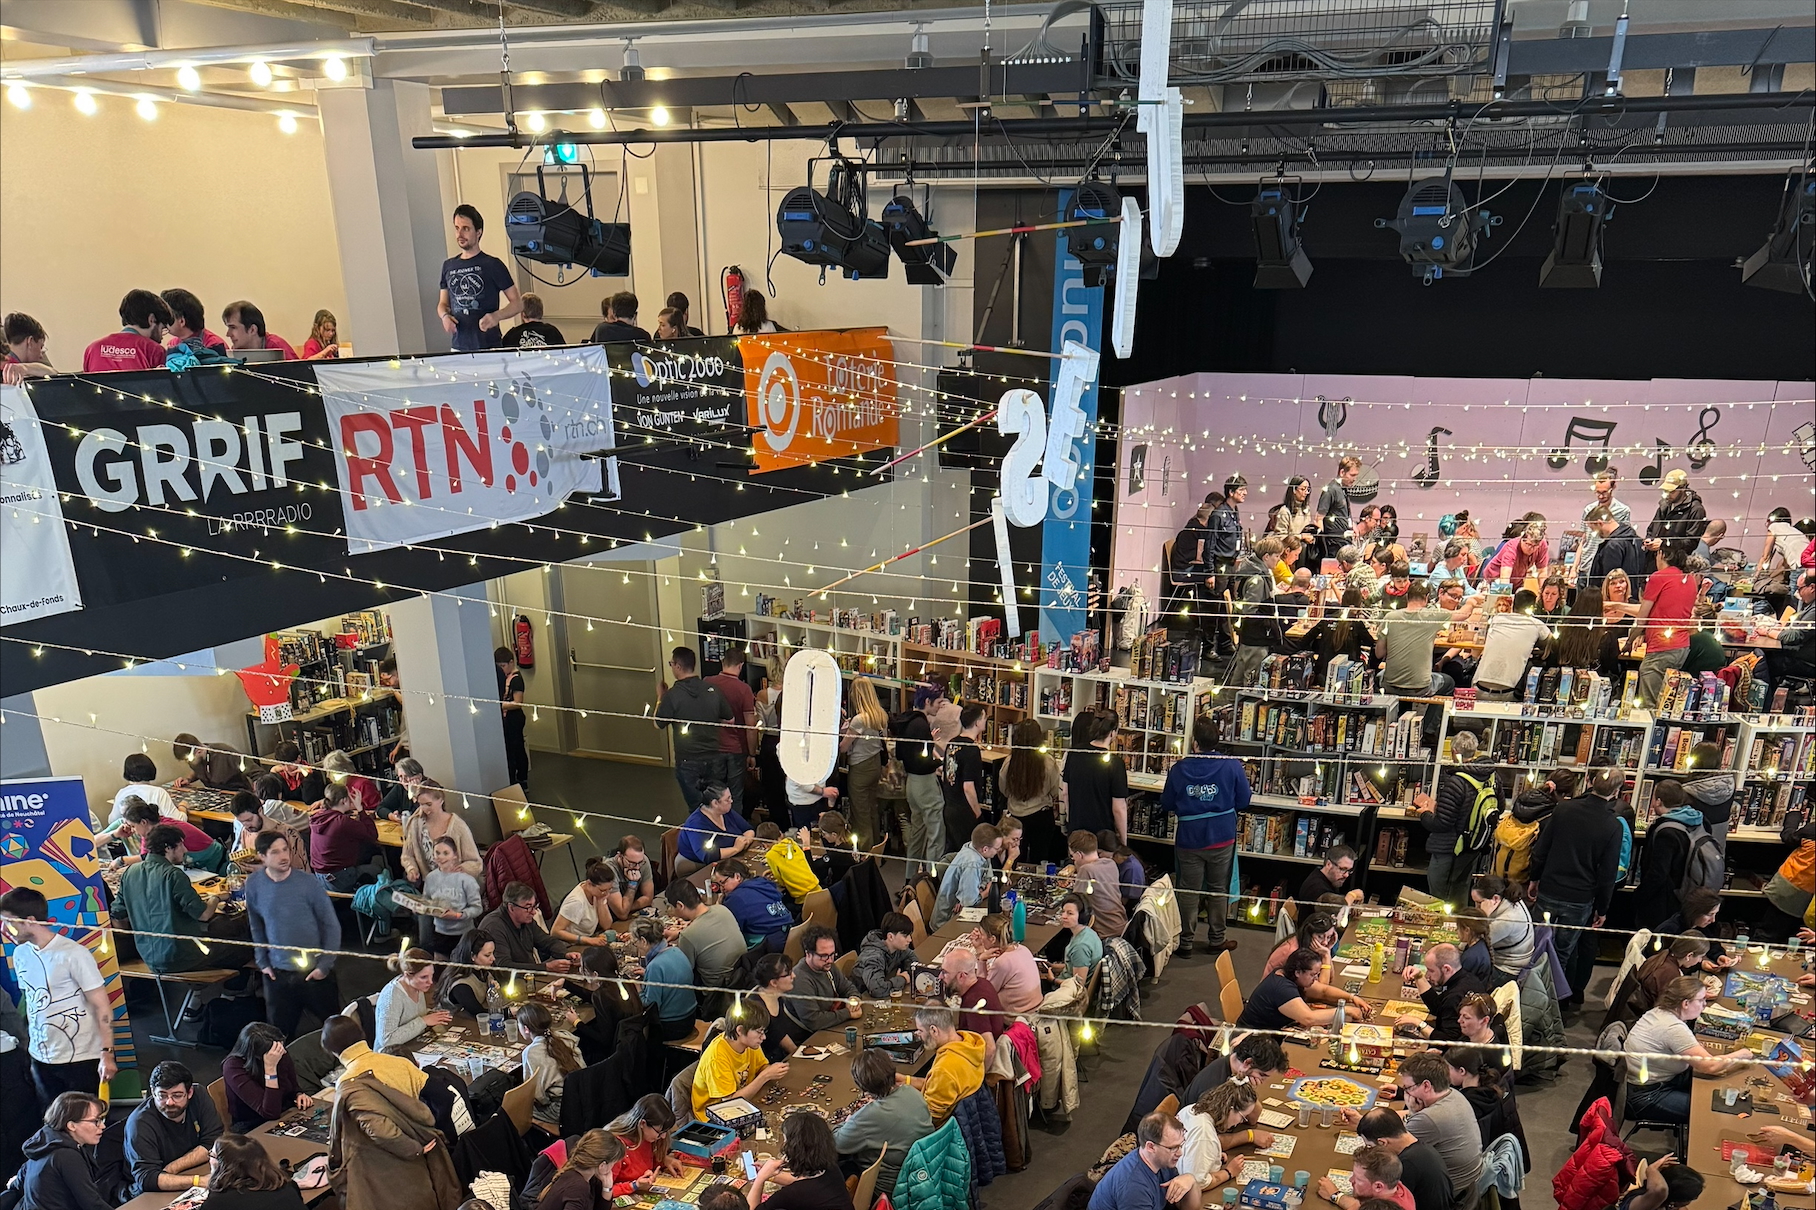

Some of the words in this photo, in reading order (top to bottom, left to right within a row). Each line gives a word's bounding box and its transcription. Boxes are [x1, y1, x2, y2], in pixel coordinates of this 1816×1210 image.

[100, 344, 137, 355] ludesco
[823, 349, 886, 396] Loterie
[636, 393, 650, 405] Une
[651, 389, 679, 403] nouvelle
[636, 414, 653, 428] VON
[810, 392, 885, 441] Romande
[563, 418, 607, 441] rtn.ch
[74, 411, 305, 513] GRRIF
[340, 399, 495, 511] RTN
[1046, 570, 1061, 589] DE
